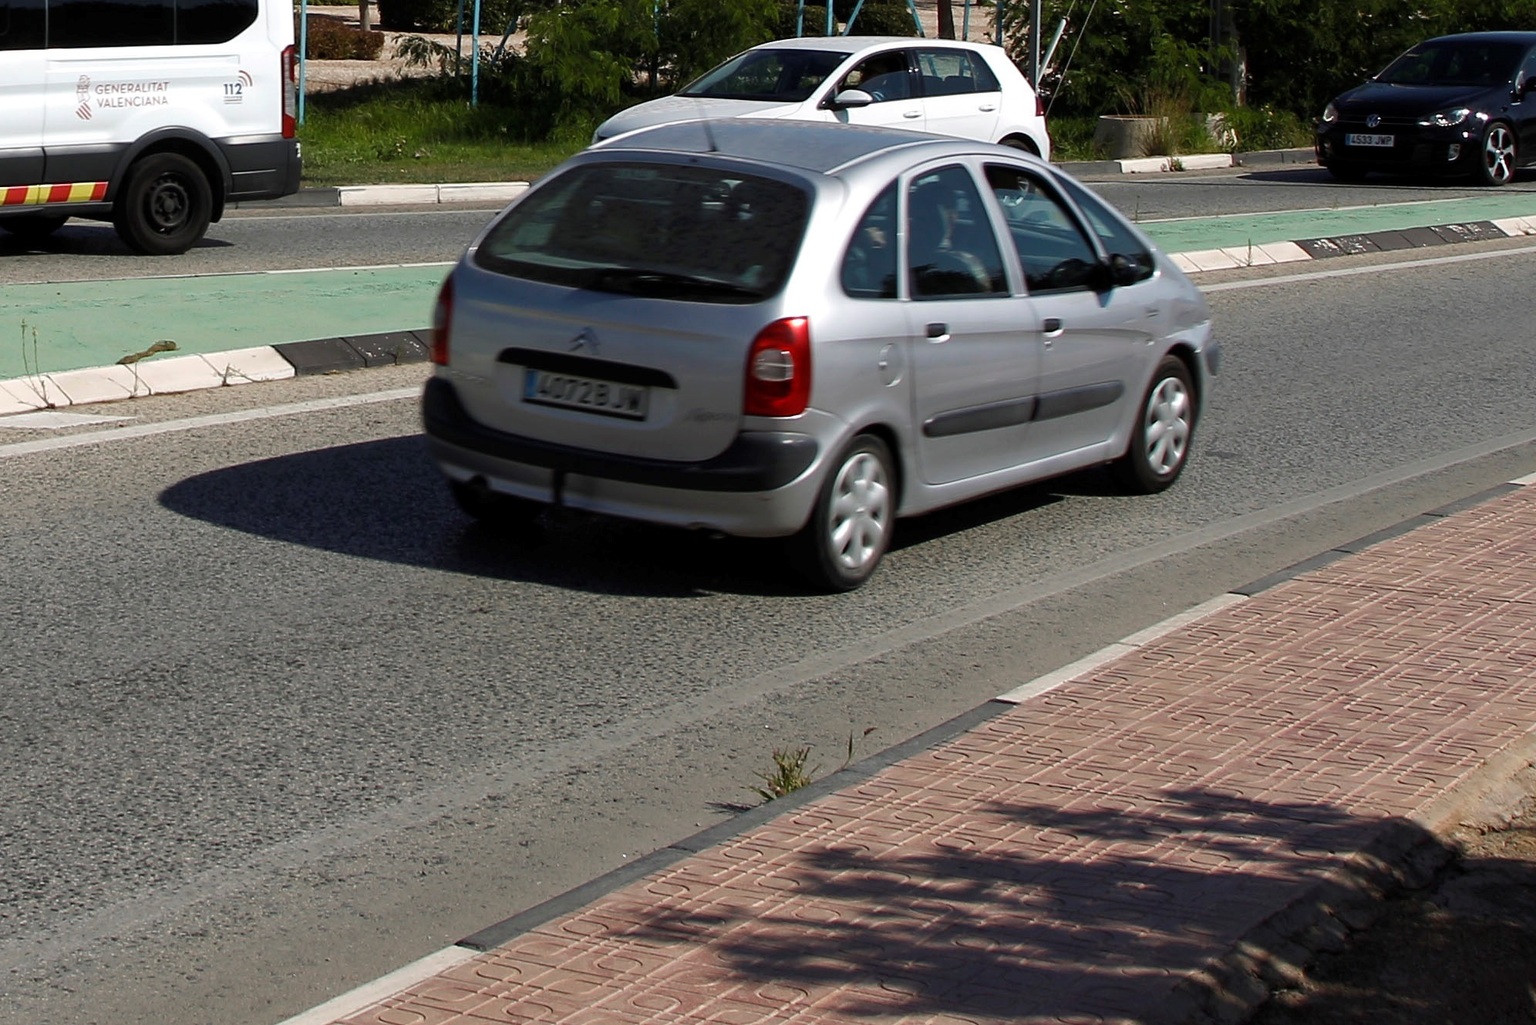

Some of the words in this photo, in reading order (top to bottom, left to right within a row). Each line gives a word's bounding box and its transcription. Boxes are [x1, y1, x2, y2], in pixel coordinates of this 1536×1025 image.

[95, 81, 170, 95] GENERALITAT
[223, 83, 243, 95] 112
[97, 95, 169, 108] VALENCIANA
[1351, 134, 1372, 145] 4533
